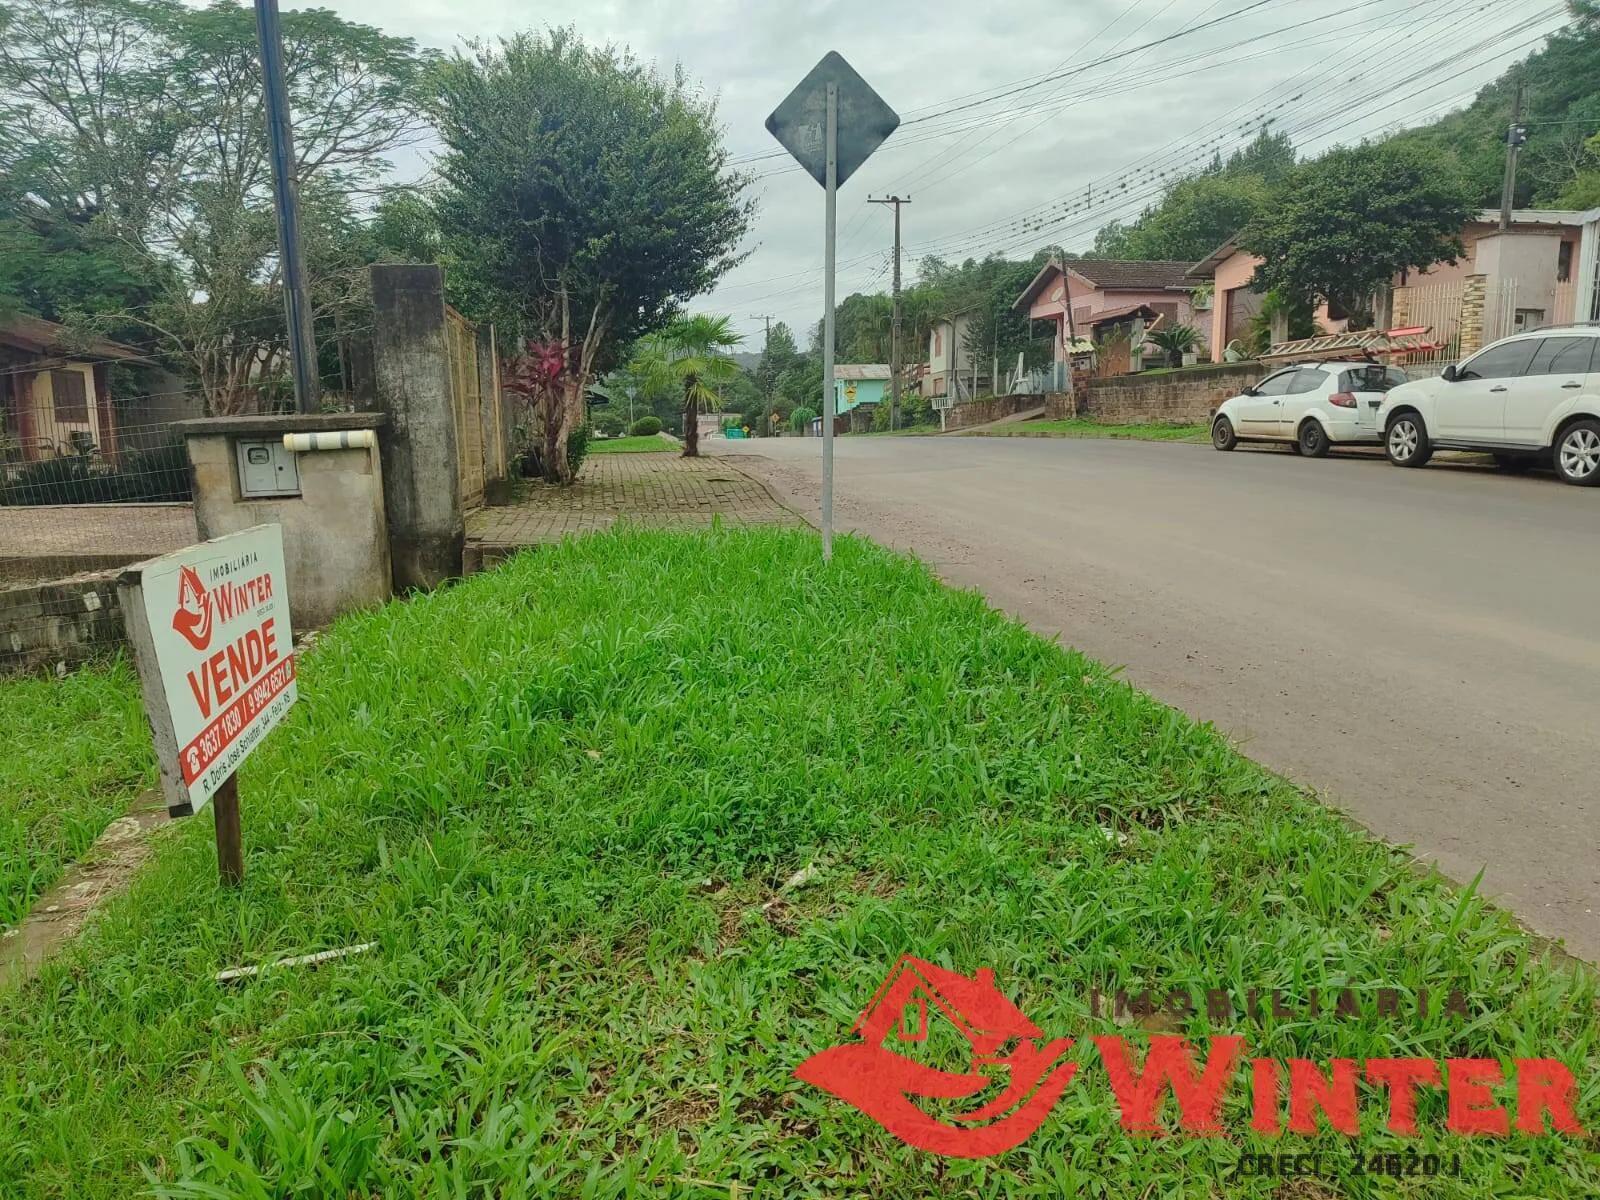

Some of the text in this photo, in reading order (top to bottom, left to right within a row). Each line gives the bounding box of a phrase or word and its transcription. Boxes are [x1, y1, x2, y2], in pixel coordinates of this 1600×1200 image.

[209, 552, 258, 582] IMOBILIÁRIA
[186, 617, 279, 719] VENDE
[199, 723, 221, 762] 3637
[222, 705, 242, 740] 1830
[248, 693, 255, 714] 9
[253, 678, 272, 708] 9942
[227, 743, 241, 768] José
